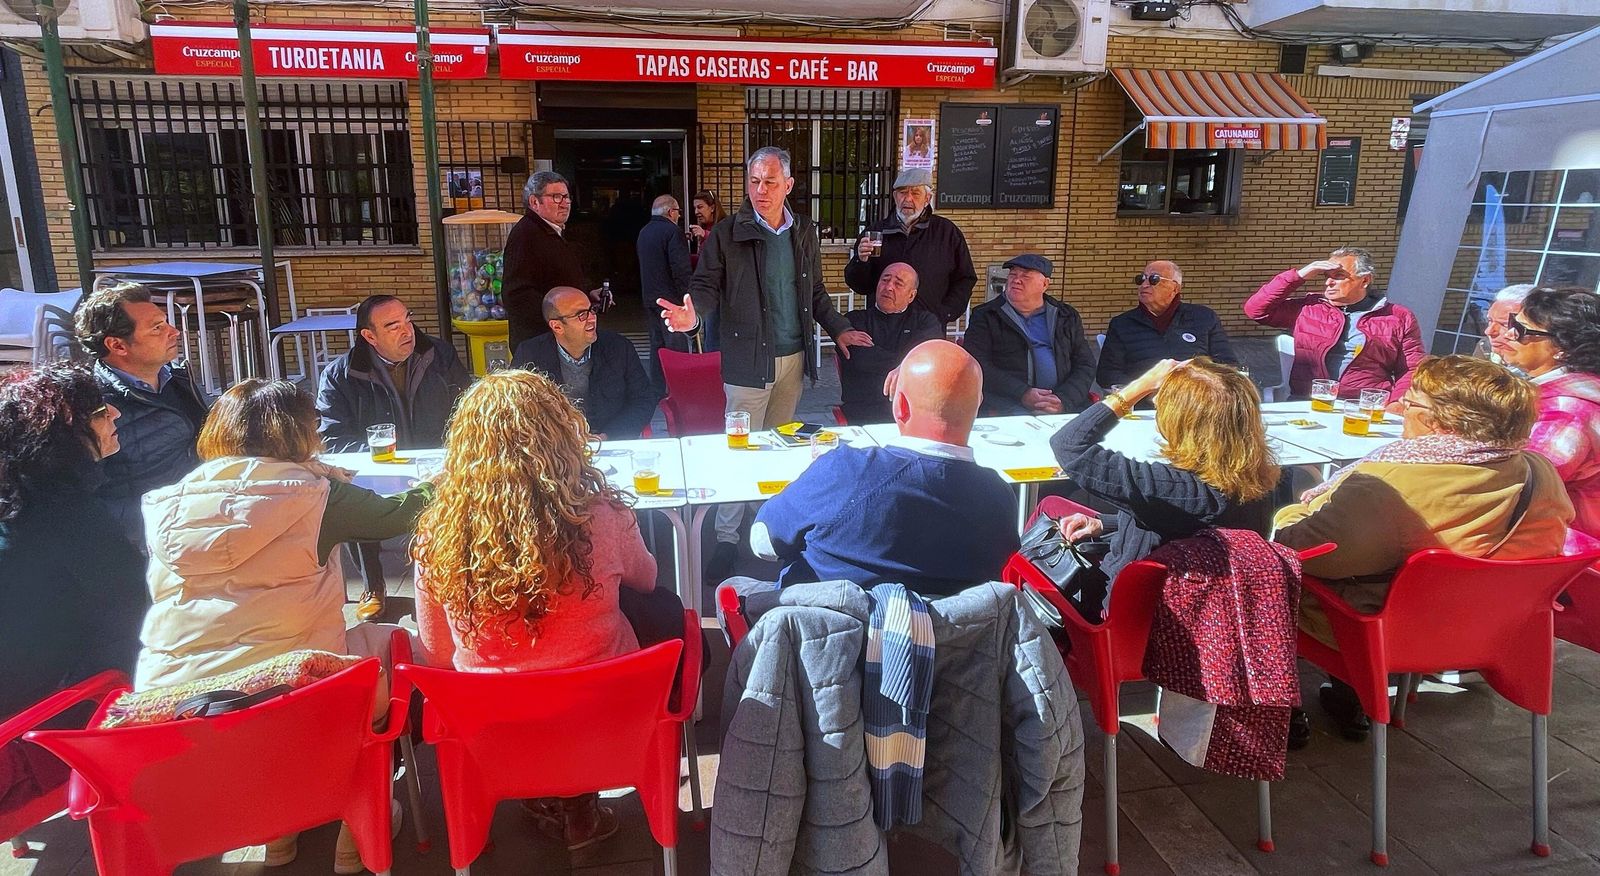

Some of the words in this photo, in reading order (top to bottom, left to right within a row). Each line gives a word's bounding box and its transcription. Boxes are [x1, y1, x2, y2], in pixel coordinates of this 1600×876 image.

[195, 60, 235, 68] ESPECIAL
[268, 46, 385, 70] TURDETANIA
[525, 52, 581, 65] Cruzcampo
[536, 65, 571, 74] ESPECIAL
[635, 54, 690, 77] TAPAS
[695, 56, 771, 79] CASERAS
[789, 56, 829, 80] CAFÉ
[847, 60, 879, 81] BAR
[926, 62, 975, 75] Cruzcampo
[935, 75, 965, 83] ESPECIAL
